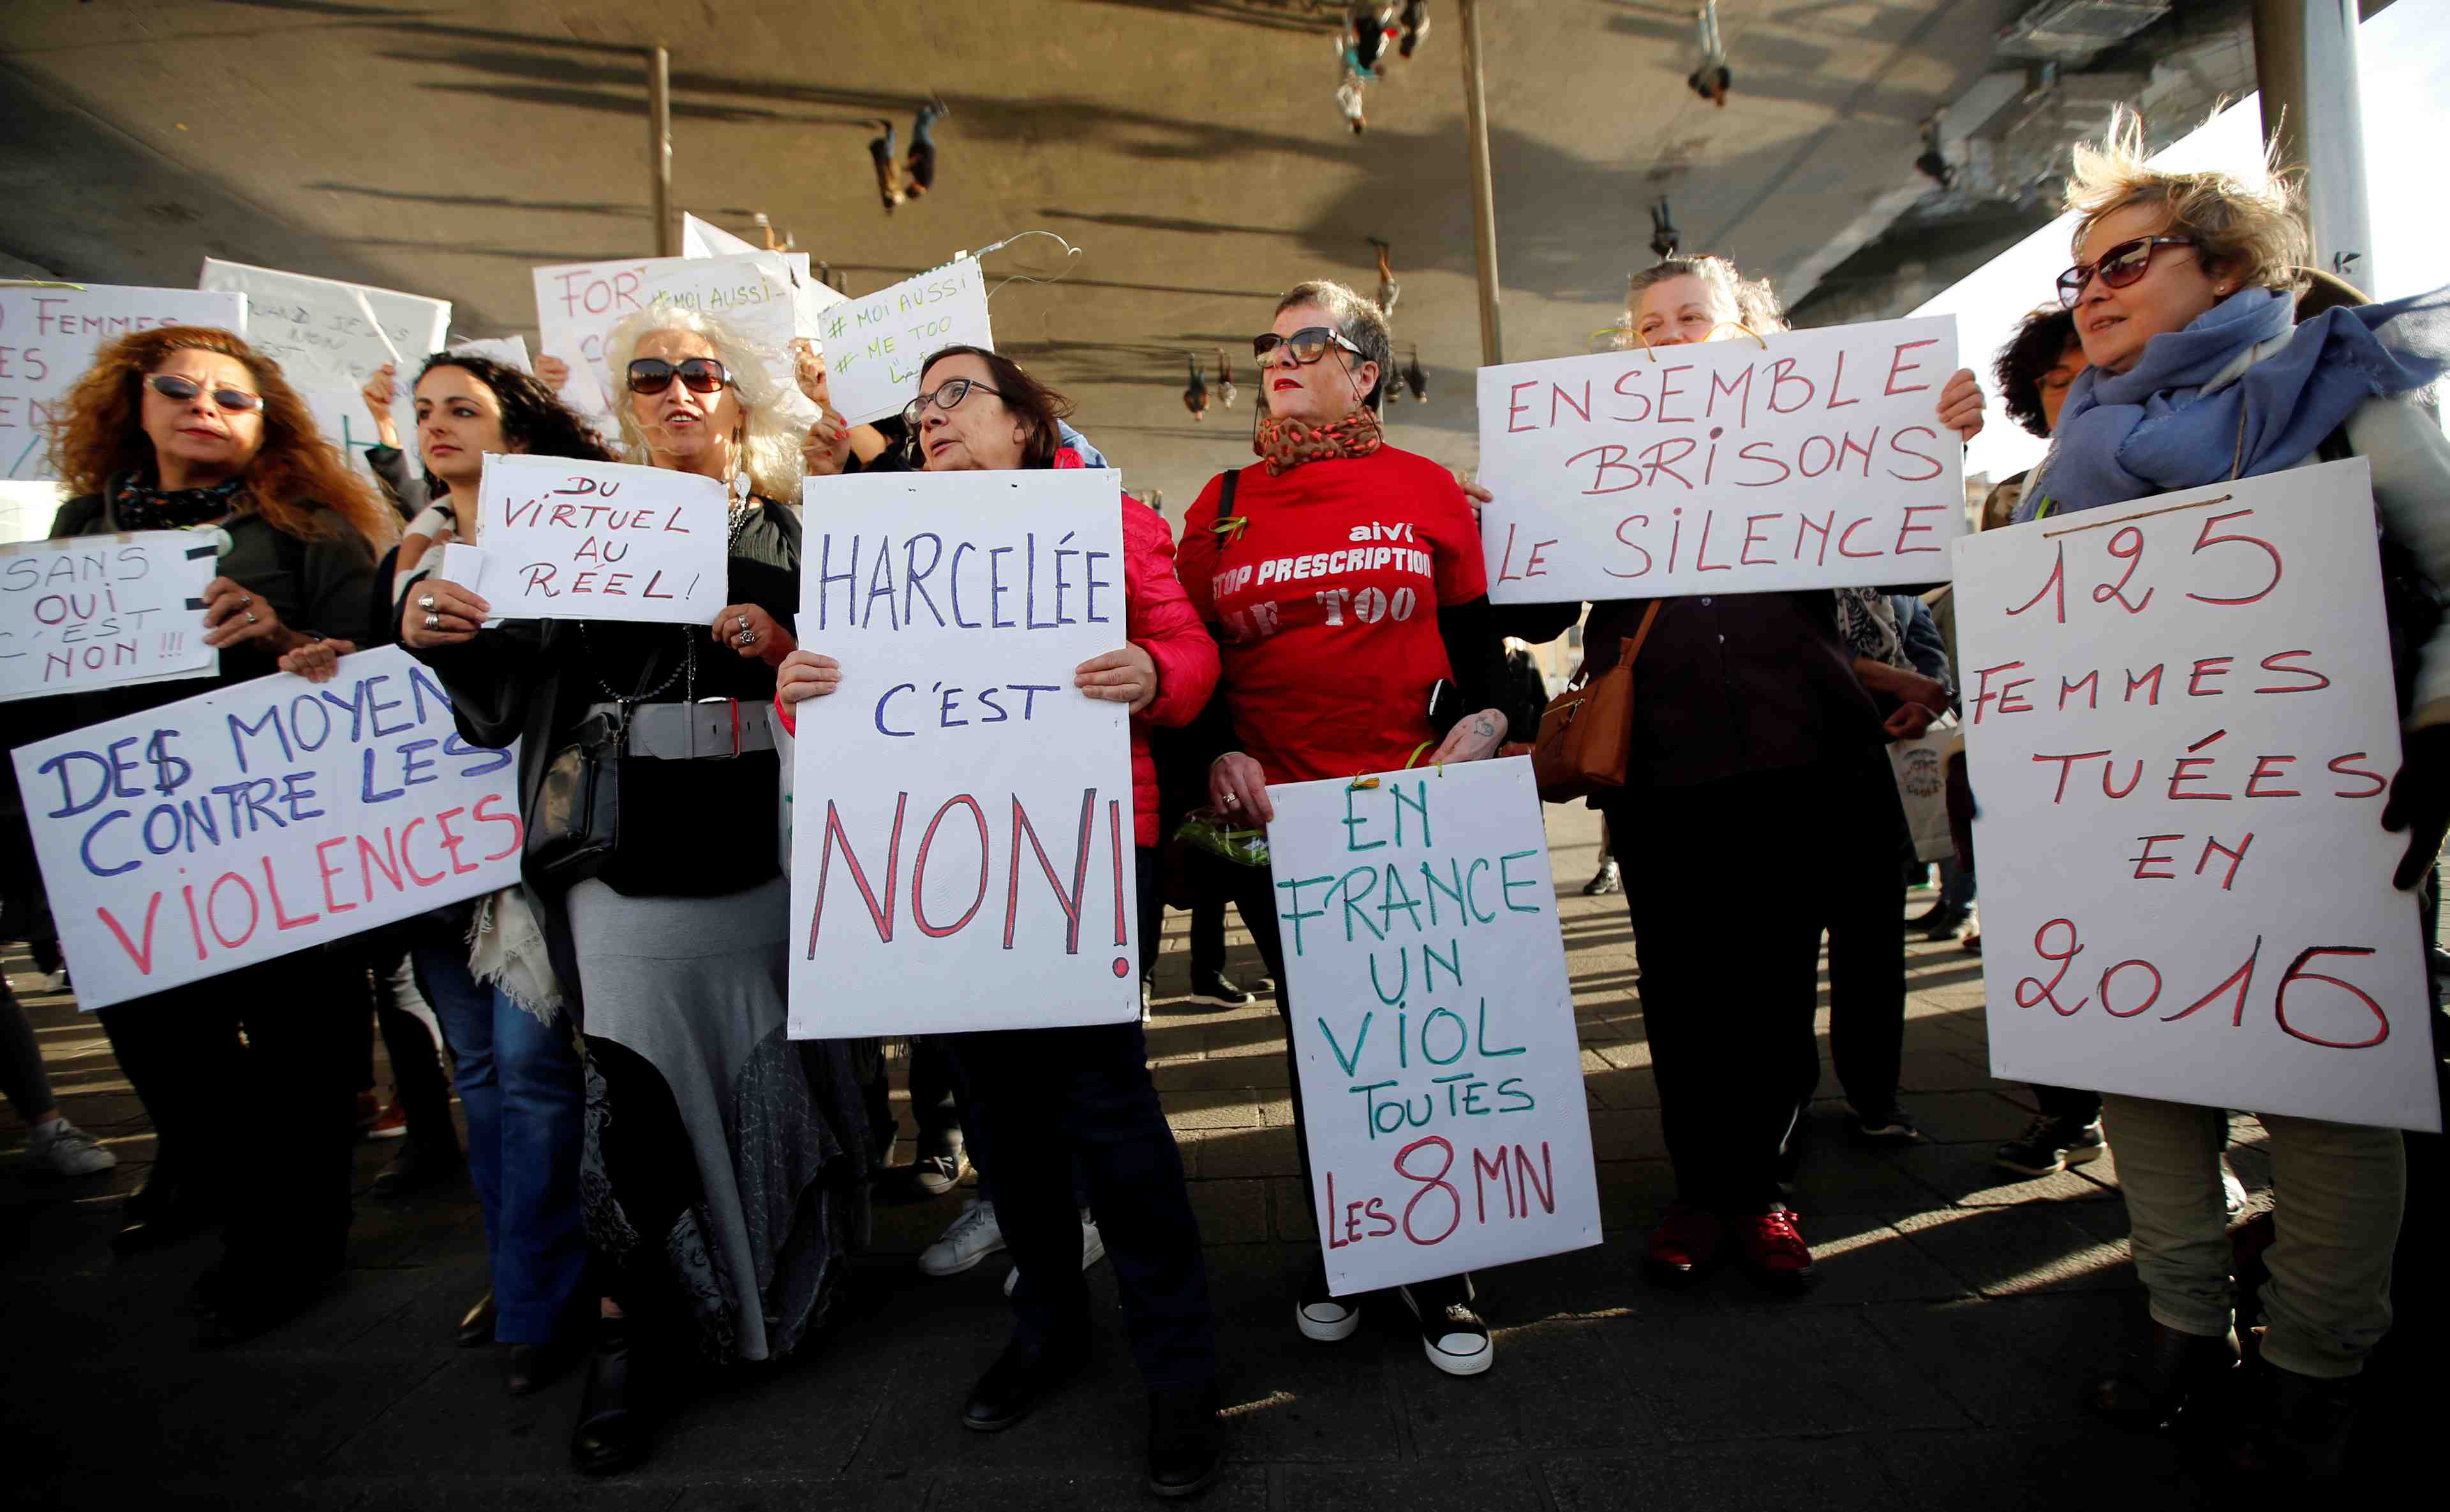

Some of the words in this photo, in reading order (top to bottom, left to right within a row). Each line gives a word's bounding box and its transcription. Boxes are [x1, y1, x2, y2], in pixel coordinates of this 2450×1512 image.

[857, 299, 890, 327] MOI
[900, 278, 967, 311] AUSSI
[867, 336, 895, 359] ME
[908, 316, 951, 340] TOO
[1508, 338, 1940, 433] ENSEMBLE
[553, 477, 620, 497] DU
[1565, 426, 1943, 495] BRISONS
[505, 493, 690, 533] VIRTUEL
[1497, 523, 1558, 586] LE
[1602, 505, 1948, 578] SILENCE
[2, 547, 150, 591] SANS
[574, 536, 628, 563] AU
[819, 531, 1110, 632] HARCELÉE
[1257, 547, 1432, 585] PRESCRIPTION
[2006, 509, 2283, 624] 125
[34, 582, 117, 625] OUI
[1316, 586, 1416, 626] TOO
[44, 639, 138, 683] NON
[1970, 649, 2331, 725] FEMMES
[875, 681, 1060, 737] C'EST
[2033, 729, 2387, 804] TUÉES
[80, 771, 326, 878] CONTRE
[362, 732, 512, 804] LES
[1340, 780, 1432, 851] EN
[97, 793, 524, 975] VIOLENCES
[807, 787, 1131, 978] NON!
[2129, 832, 2254, 891] EN
[1277, 850, 1540, 956] FRANCE
[1370, 939, 1462, 1005] UN
[2015, 918, 2389, 1049] 2016
[1318, 996, 1526, 1078] VIOL
[1349, 1072, 1535, 1140] TOUTES
[1326, 1171, 1397, 1250] LES
[1393, 1135, 1461, 1245] 8
[1473, 1141, 1554, 1223] MN
